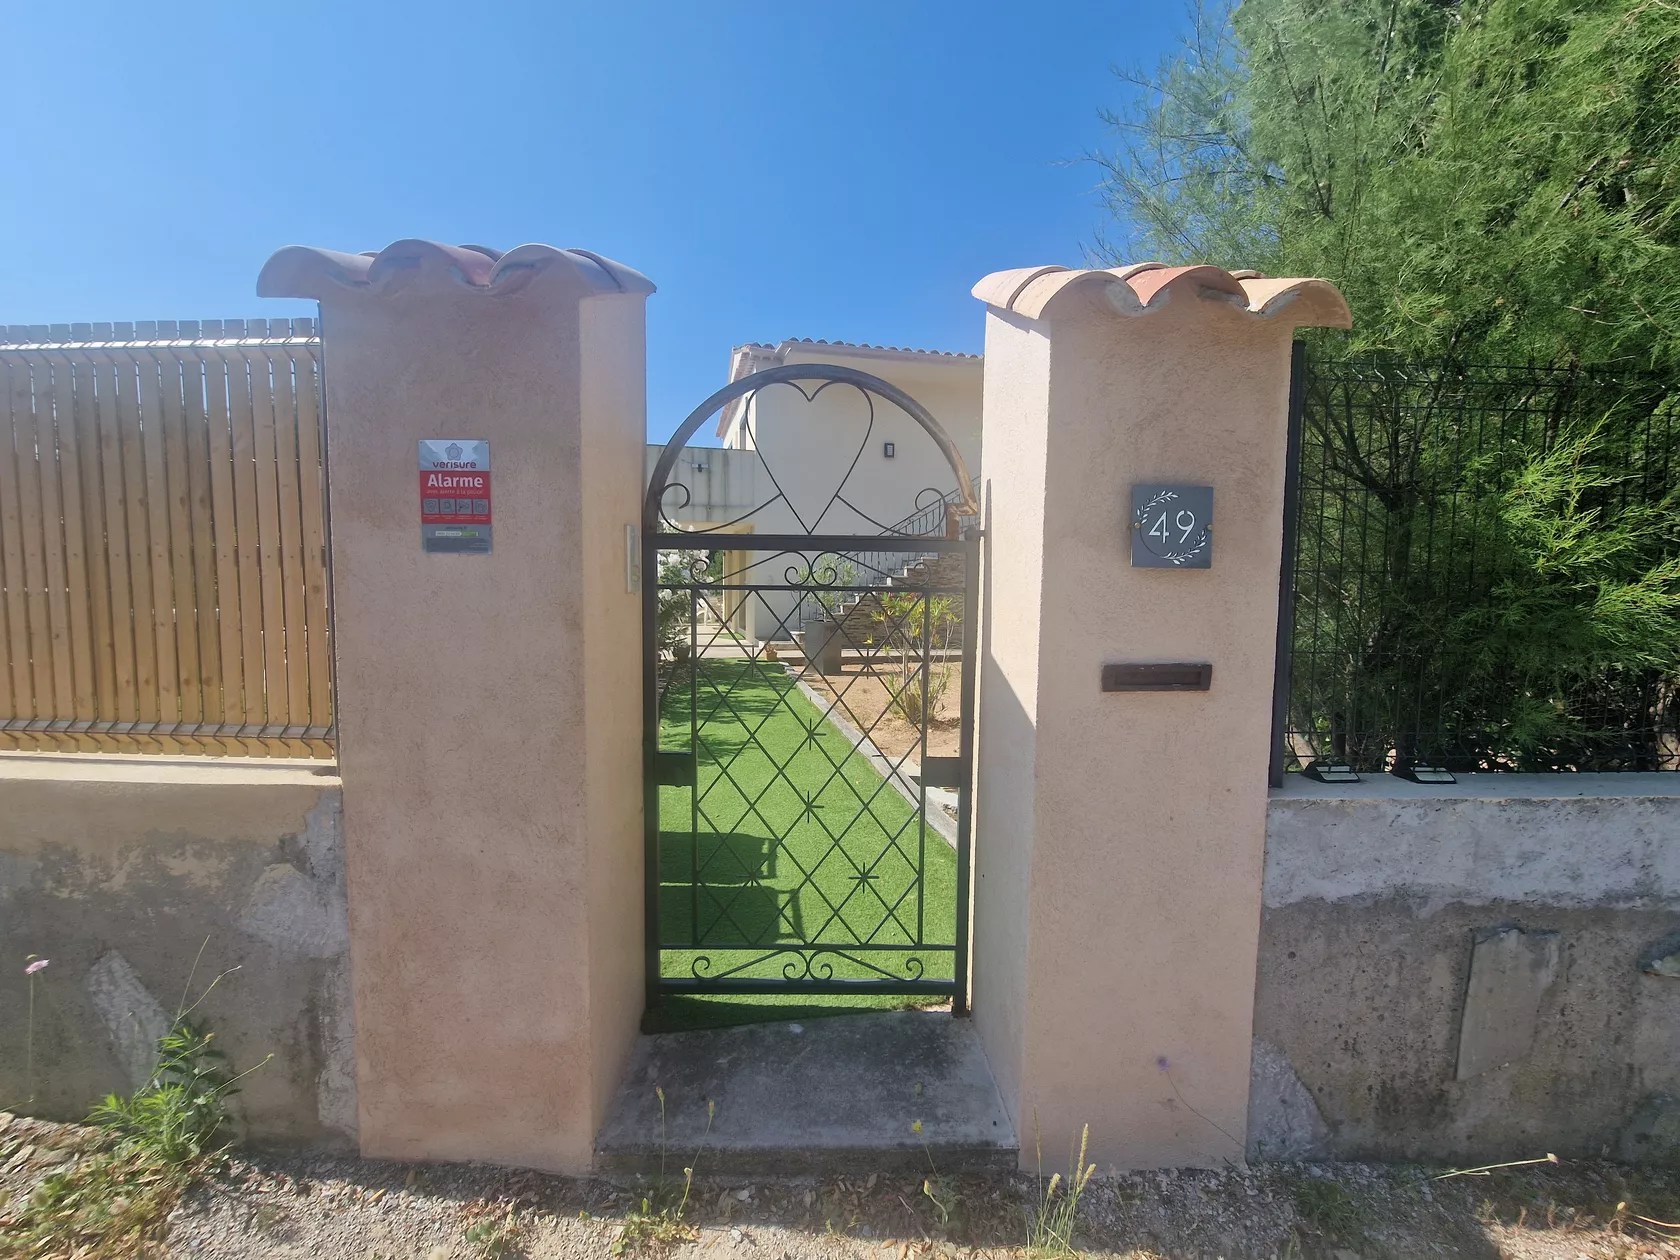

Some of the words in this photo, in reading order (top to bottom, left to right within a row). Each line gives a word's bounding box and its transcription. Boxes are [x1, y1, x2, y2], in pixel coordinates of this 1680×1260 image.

[432, 461, 477, 469] verisure
[427, 473, 483, 488] Alarme
[1148, 510, 1195, 544] 49
